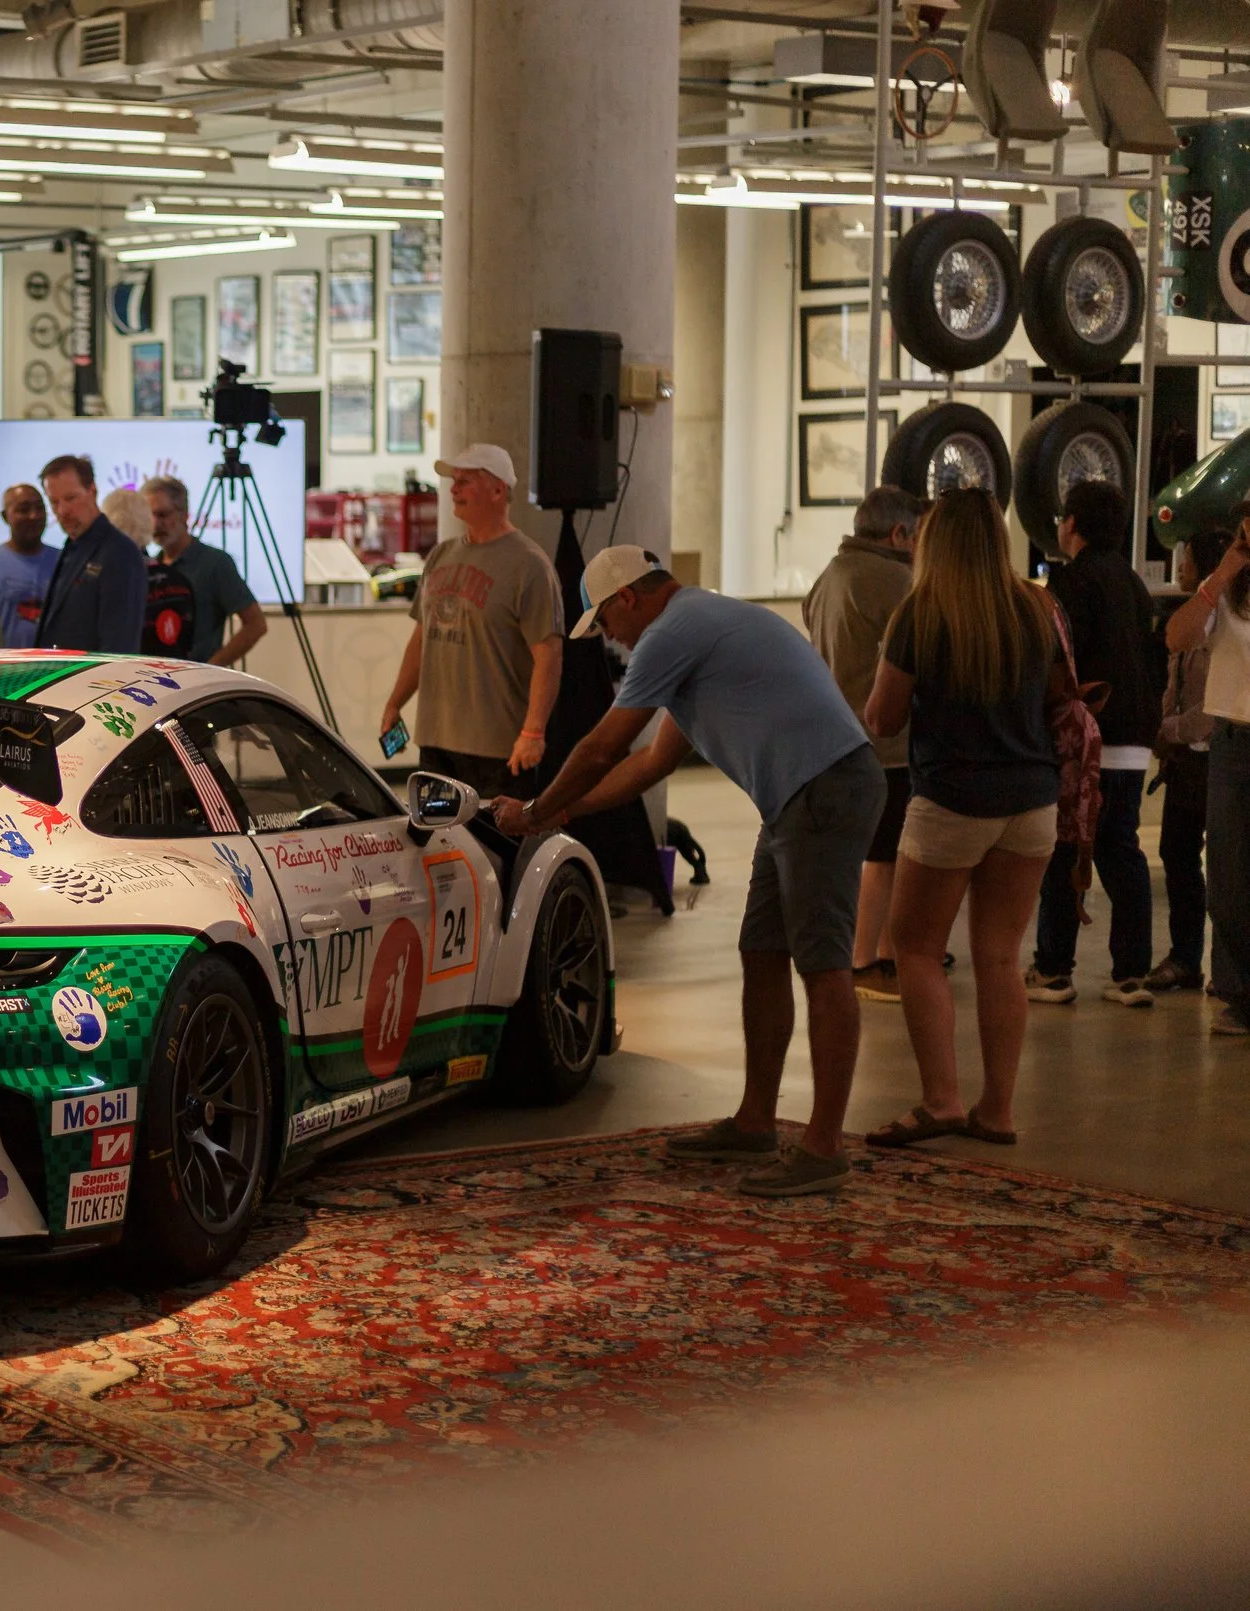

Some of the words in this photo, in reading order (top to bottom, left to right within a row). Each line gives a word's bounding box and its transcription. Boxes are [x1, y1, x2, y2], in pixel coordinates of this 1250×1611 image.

[1173, 201, 1188, 244] 497
[1190, 196, 1212, 248] XSK
[74, 243, 91, 281] LIFT
[3, 761, 30, 770] AVIATION
[265, 844, 327, 874] Racing
[321, 838, 347, 872] for
[344, 832, 403, 858] Children's
[100, 863, 175, 885] PACIFIC
[118, 878, 175, 894] WINDOWS
[441, 907, 466, 959] 24
[63, 1092, 127, 1130] Mobil
[71, 1179, 127, 1198] Illustrated
[81, 1171, 120, 1186] Sports
[70, 1194, 125, 1225] TICKETS
